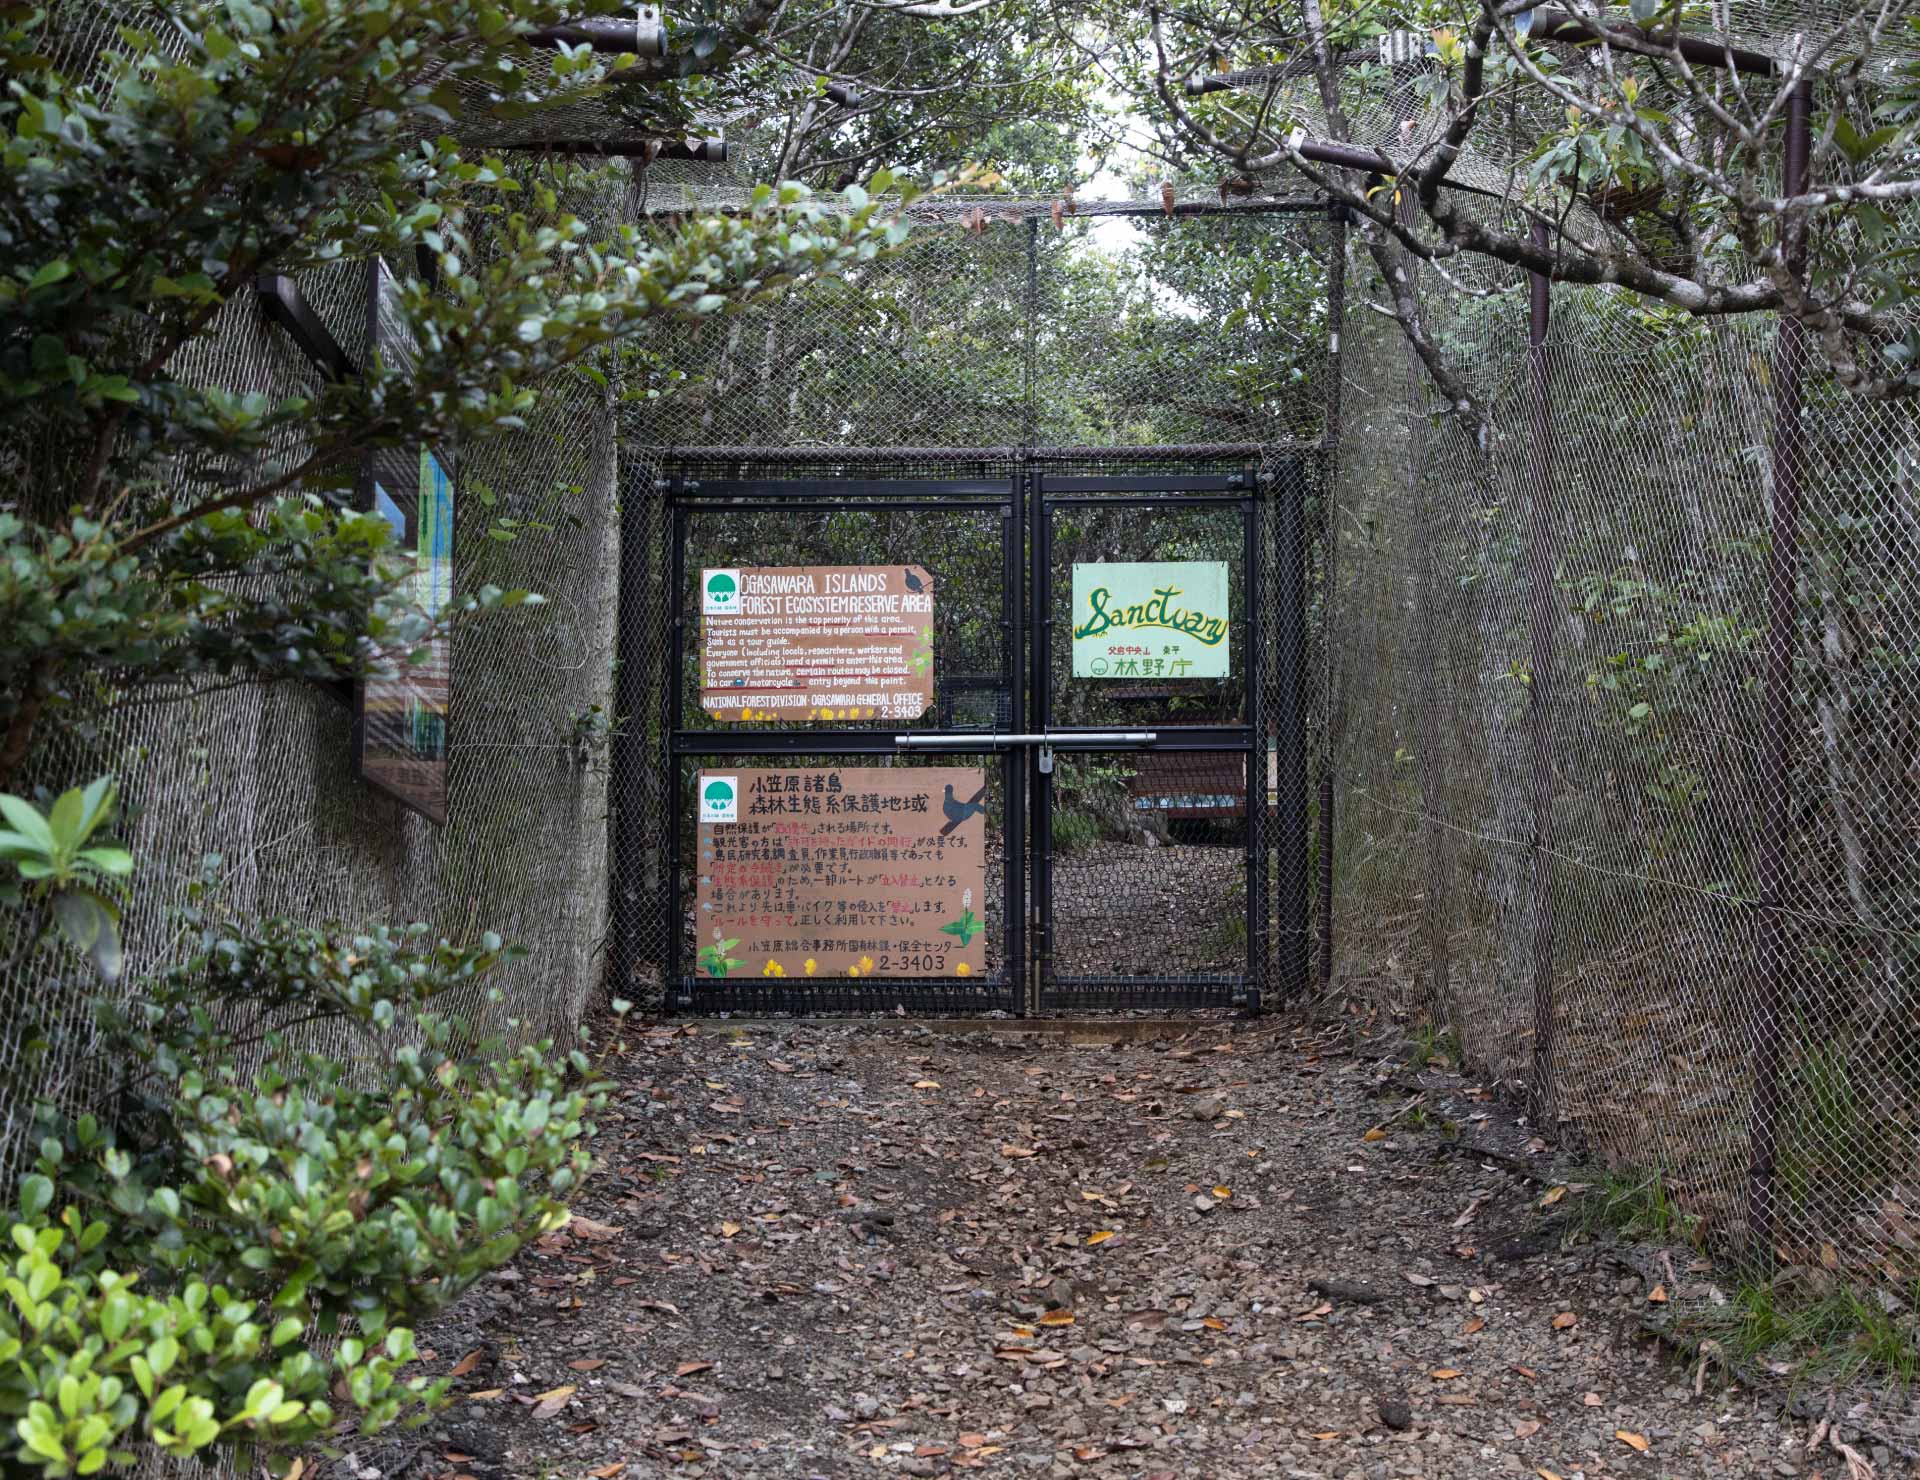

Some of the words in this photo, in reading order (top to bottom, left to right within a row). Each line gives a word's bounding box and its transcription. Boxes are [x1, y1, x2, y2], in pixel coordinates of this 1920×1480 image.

[740, 574, 815, 595] OGASAWARA
[825, 573, 887, 594] ISLANDS
[740, 595, 783, 616] FOREST
[786, 595, 848, 614] ECOSYSTEM
[849, 594, 899, 614] RESERVE
[901, 593, 932, 614] AREA
[706, 615, 733, 627] Nature
[734, 616, 783, 625] conservation
[785, 616, 793, 625] is
[796, 614, 808, 624] the
[808, 615, 822, 627] top
[823, 614, 852, 627] priority
[853, 614, 863, 624] of
[864, 615, 879, 624] this
[1073, 584, 1229, 646] Sanctuary
[707, 627, 737, 637] Tourists
[739, 628, 759, 637] must
[761, 626, 771, 635] be
[773, 626, 821, 637] accompanied
[823, 625, 832, 636] by
[839, 627, 864, 636] person
[864, 625, 880, 634] with
[706, 637, 724, 647] Such
[747, 638, 765, 646] tour
[766, 636, 791, 648] guide.
[706, 646, 738, 659] Everyone
[741, 646, 780, 659] (including
[857, 644, 888, 654] workers
[888, 643, 903, 654] and
[1108, 645, 1151, 656] 父島中央山
[1162, 645, 1180, 656] 東平
[706, 659, 749, 670] government
[750, 657, 786, 667] officials)
[786, 657, 804, 666] need
[811, 656, 835, 667] permit
[836, 656, 845, 664] to
[867, 655, 882, 664] this
[1114, 657, 1193, 677] 林野庁
[706, 669, 717, 678] To
[718, 668, 750, 677] conserve
[752, 667, 765, 676] the
[796, 666, 826, 676] certain
[827, 667, 854, 675] routes
[854, 667, 870, 677] may
[871, 665, 881, 674] be
[882, 664, 911, 674] closed.
[706, 678, 717, 688] No
[719, 679, 733, 687] car
[808, 677, 832, 688] entry
[833, 675, 861, 688] beyond
[864, 676, 878, 685] this
[880, 677, 907, 688] point.
[703, 695, 742, 709] NATIONAL
[742, 695, 771, 708] FOREST
[770, 694, 808, 708] DIVISION
[811, 693, 855, 706] OGASAWARA
[856, 692, 893, 706] GENERAL
[893, 692, 924, 705] OFFICE
[881, 705, 922, 718] 2-3403
[749, 772, 843, 794] 小笠原諸島
[748, 793, 930, 815] 森林生態系保護地域
[711, 887, 800, 900] 場合があります。
[879, 954, 946, 971] 2-3403
